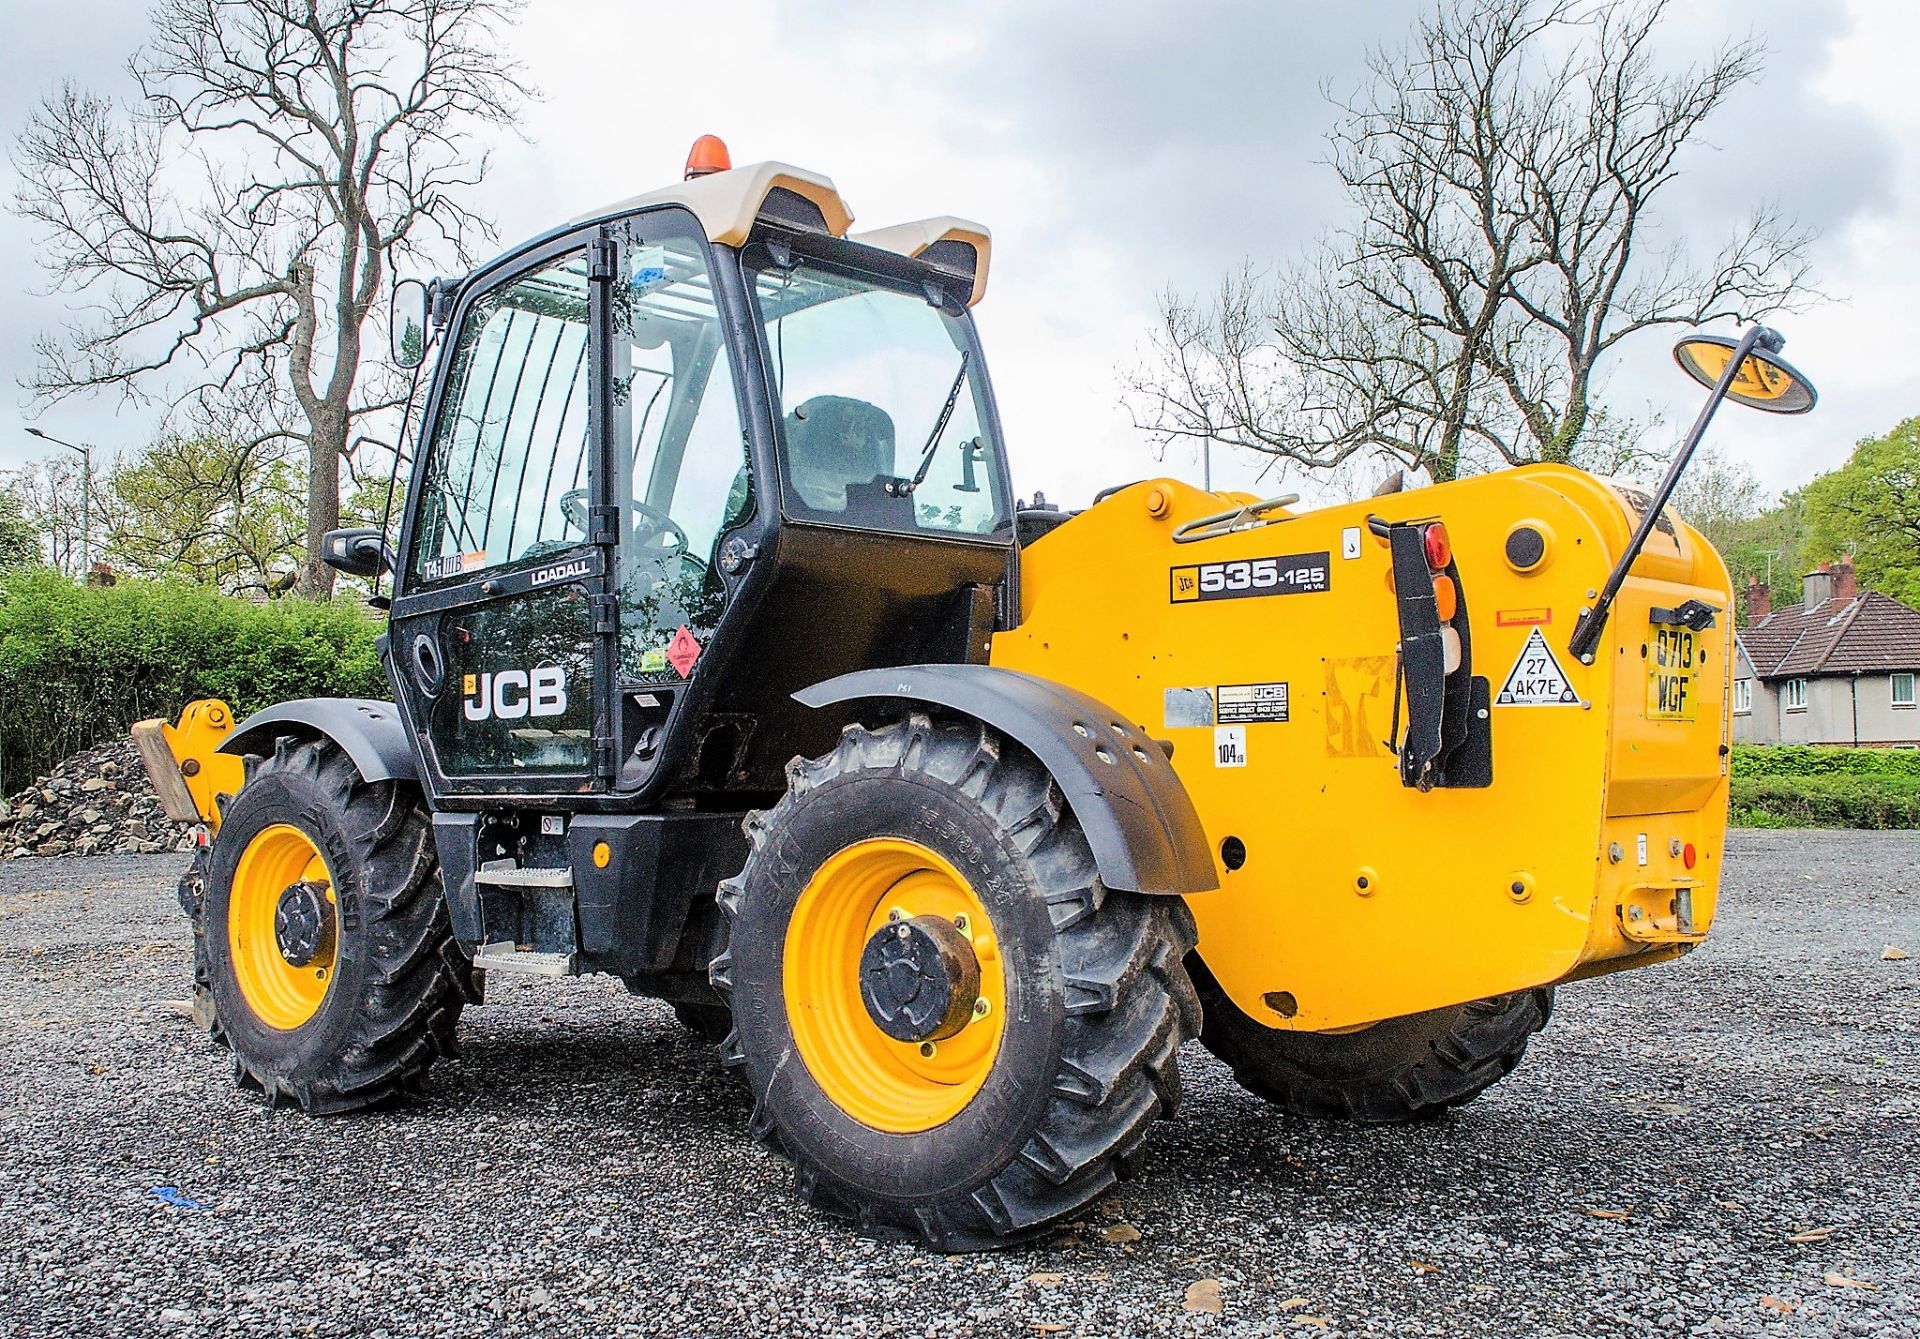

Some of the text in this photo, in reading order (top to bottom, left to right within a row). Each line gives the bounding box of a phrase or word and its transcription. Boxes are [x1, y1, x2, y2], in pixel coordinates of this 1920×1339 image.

[424, 560, 443, 580] T4i
[531, 560, 590, 586] LOADALL
[1178, 577, 1195, 592] JCB
[1657, 630, 1693, 669] Q713
[1526, 659, 1547, 675] 27
[464, 667, 567, 722] JCB
[1254, 686, 1285, 700] JCB
[1515, 679, 1559, 696] AK7E
[1229, 732, 1235, 740] L
[1218, 744, 1236, 763] 104
